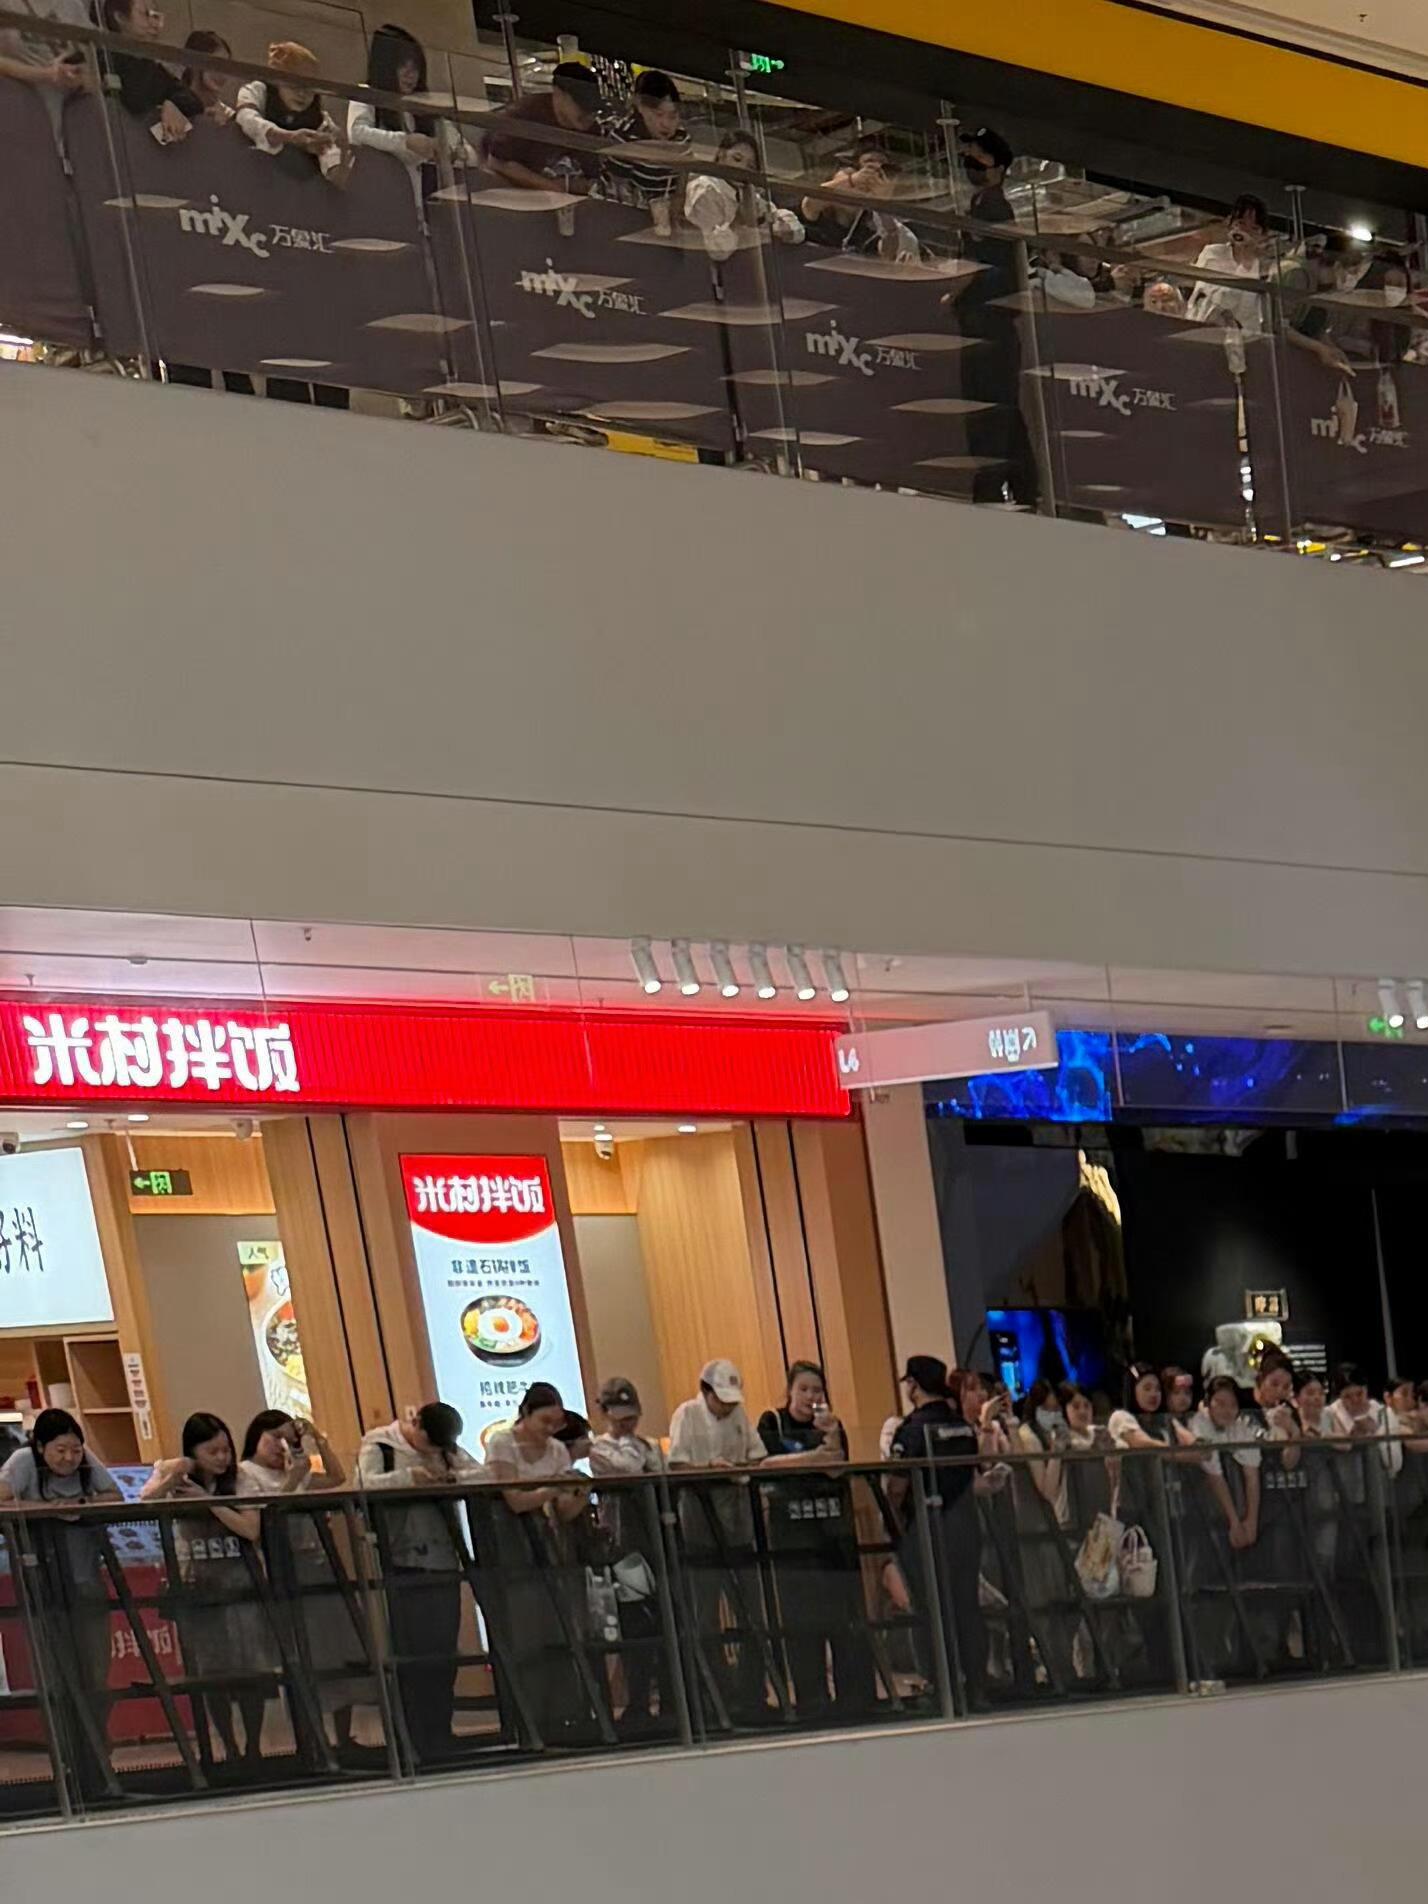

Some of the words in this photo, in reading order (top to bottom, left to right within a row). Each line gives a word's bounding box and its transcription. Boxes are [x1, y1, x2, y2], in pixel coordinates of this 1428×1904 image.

[1310, 405, 1367, 453] mic
[23, 1014, 300, 1092] 米村拌饭
[413, 1176, 545, 1213] 米村拌饭
